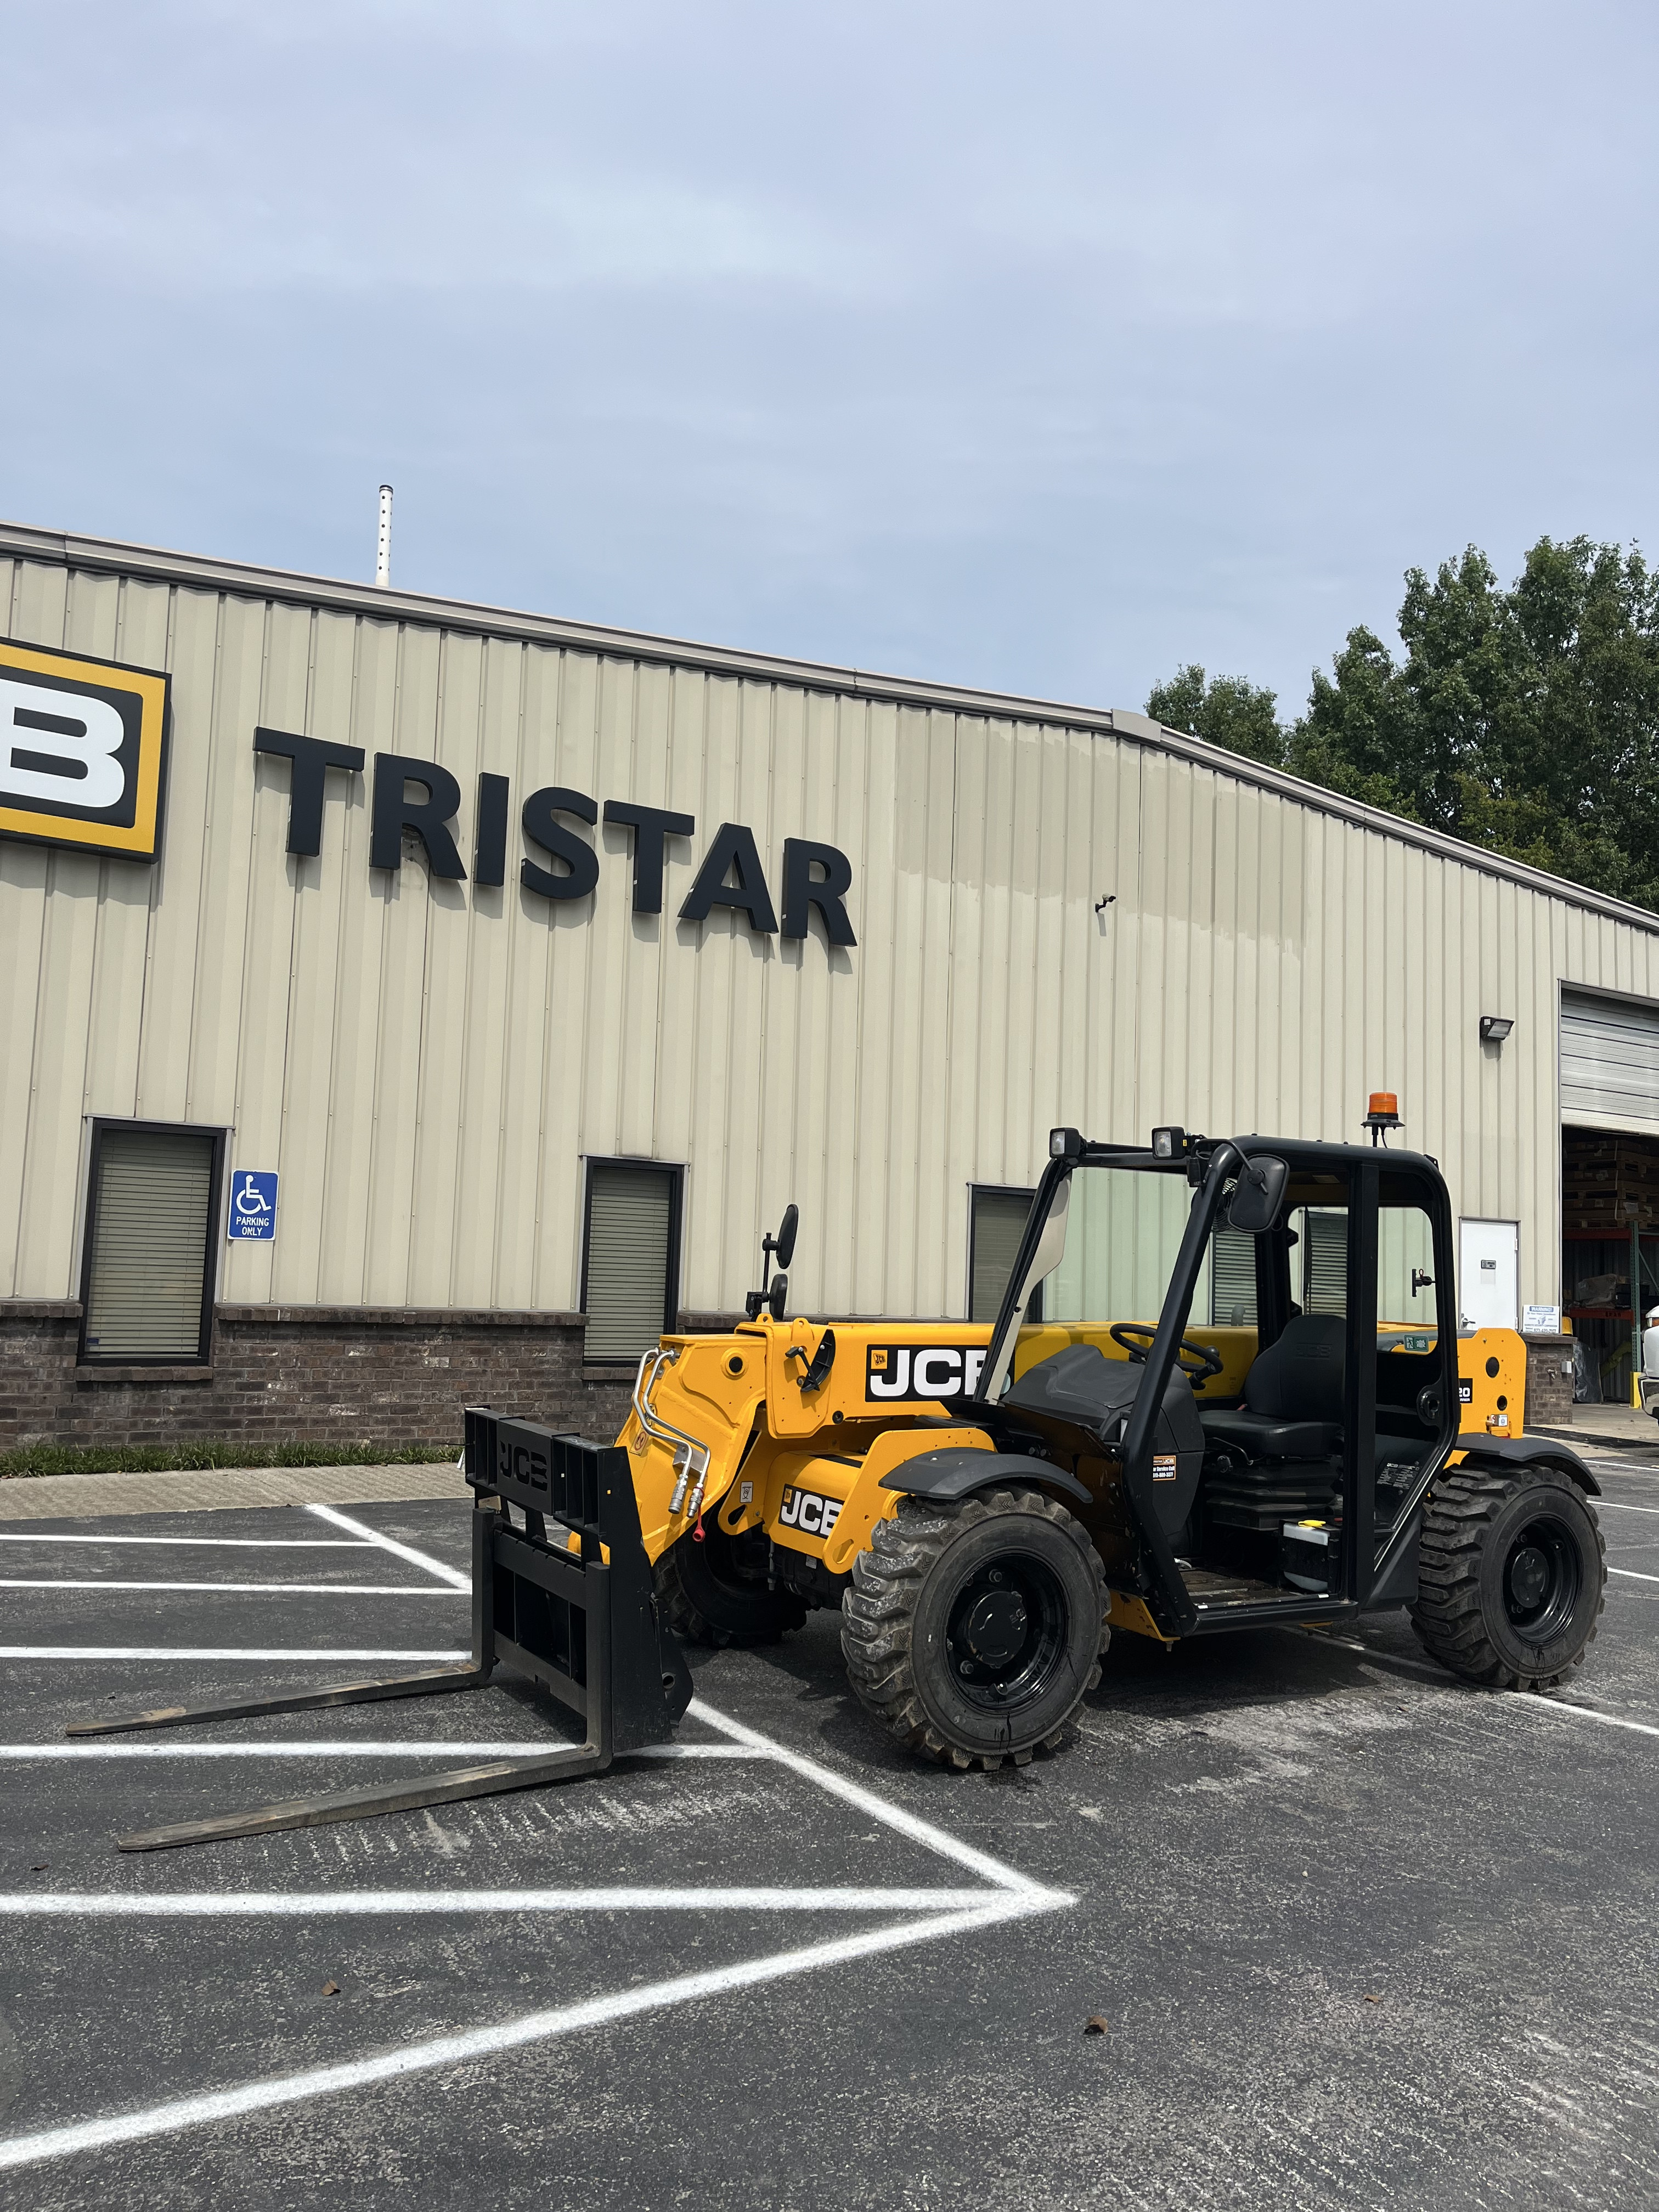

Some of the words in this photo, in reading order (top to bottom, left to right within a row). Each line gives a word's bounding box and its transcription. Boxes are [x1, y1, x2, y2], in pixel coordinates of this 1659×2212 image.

[253, 726, 858, 946] TRISTAR
[236, 1216, 269, 1226] PARKING
[242, 1226, 263, 1235] ONLY
[500, 1441, 548, 1492] JCB
